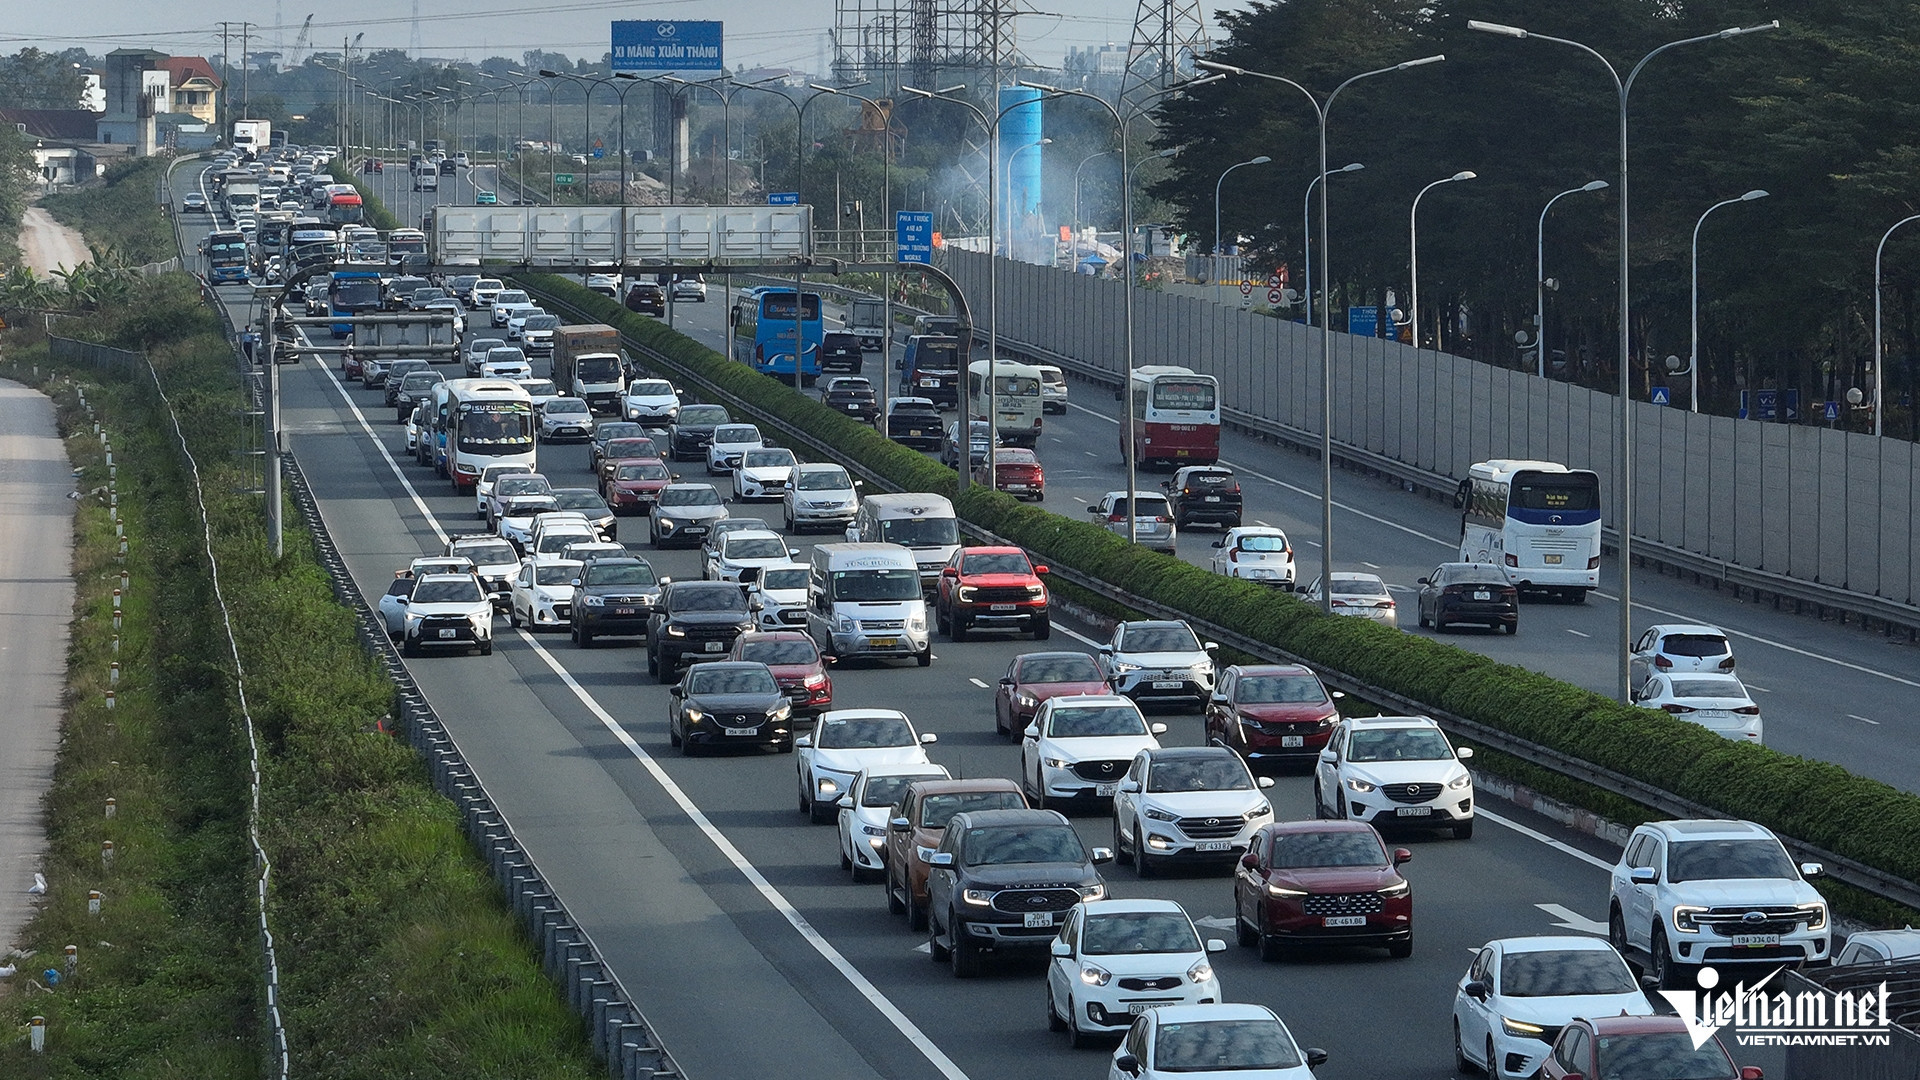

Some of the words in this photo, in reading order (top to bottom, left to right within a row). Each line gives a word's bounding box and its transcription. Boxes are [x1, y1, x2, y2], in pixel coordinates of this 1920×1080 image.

[615, 46, 624, 58] XI
[627, 43, 655, 58] MĂNG
[658, 43, 684, 58] XUÂN
[686, 43, 718, 58] THÀNH
